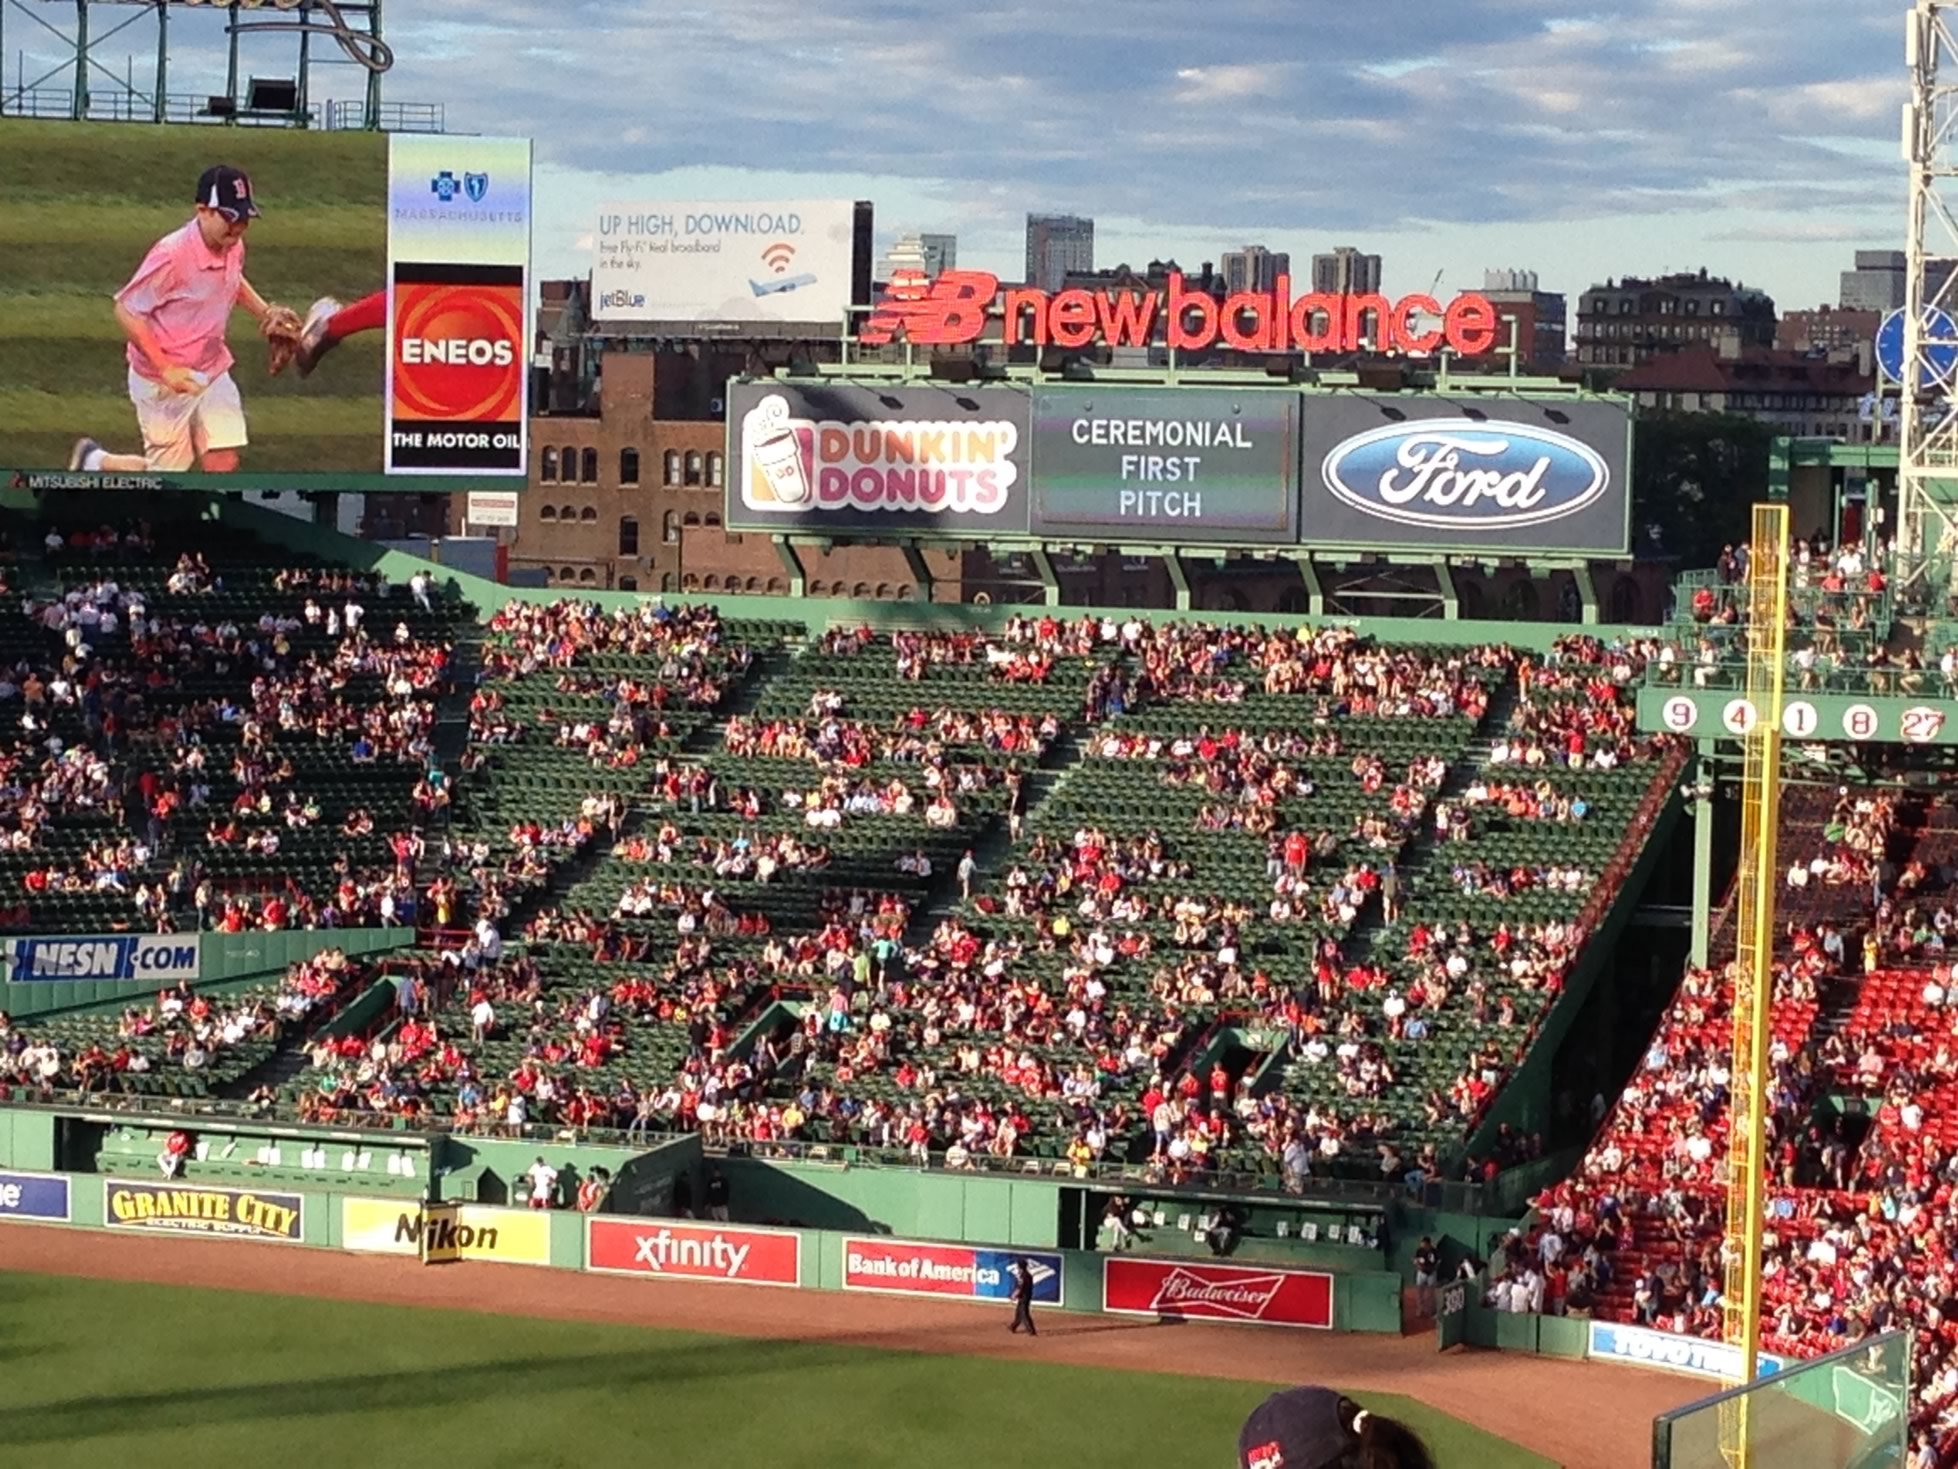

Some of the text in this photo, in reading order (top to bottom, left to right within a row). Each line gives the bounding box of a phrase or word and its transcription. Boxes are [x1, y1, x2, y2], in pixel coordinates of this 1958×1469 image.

[600, 213, 805, 238] UP HIGH, DOWNLOAD.
[671, 240, 721, 253] broadband
[600, 289, 646, 312] jetBlue
[1005, 289, 1158, 348] new
[1167, 272, 1496, 355] balance
[401, 338, 514, 366] ENEOS
[393, 433, 520, 449] THE MOTOR OIL
[820, 427, 1009, 465] DUNKIN'
[1072, 419, 1253, 448] CEREMONIAL
[29, 475, 162, 490] MITSUBISHI ELECTRIC
[1121, 455, 1201, 482] FIRST
[1379, 433, 1551, 509] Ford
[820, 467, 998, 503] DONUTS
[1120, 490, 1201, 517] PITCH
[1672, 703, 1946, 737] 9 4 1 8 27
[112, 1190, 298, 1236] GRANITE CITY
[394, 1213, 498, 1251] Nikon
[635, 1229, 750, 1277] xfinity
[848, 1253, 1000, 1285] Bank of America
[1162, 1276, 1271, 1304] Budweiser
